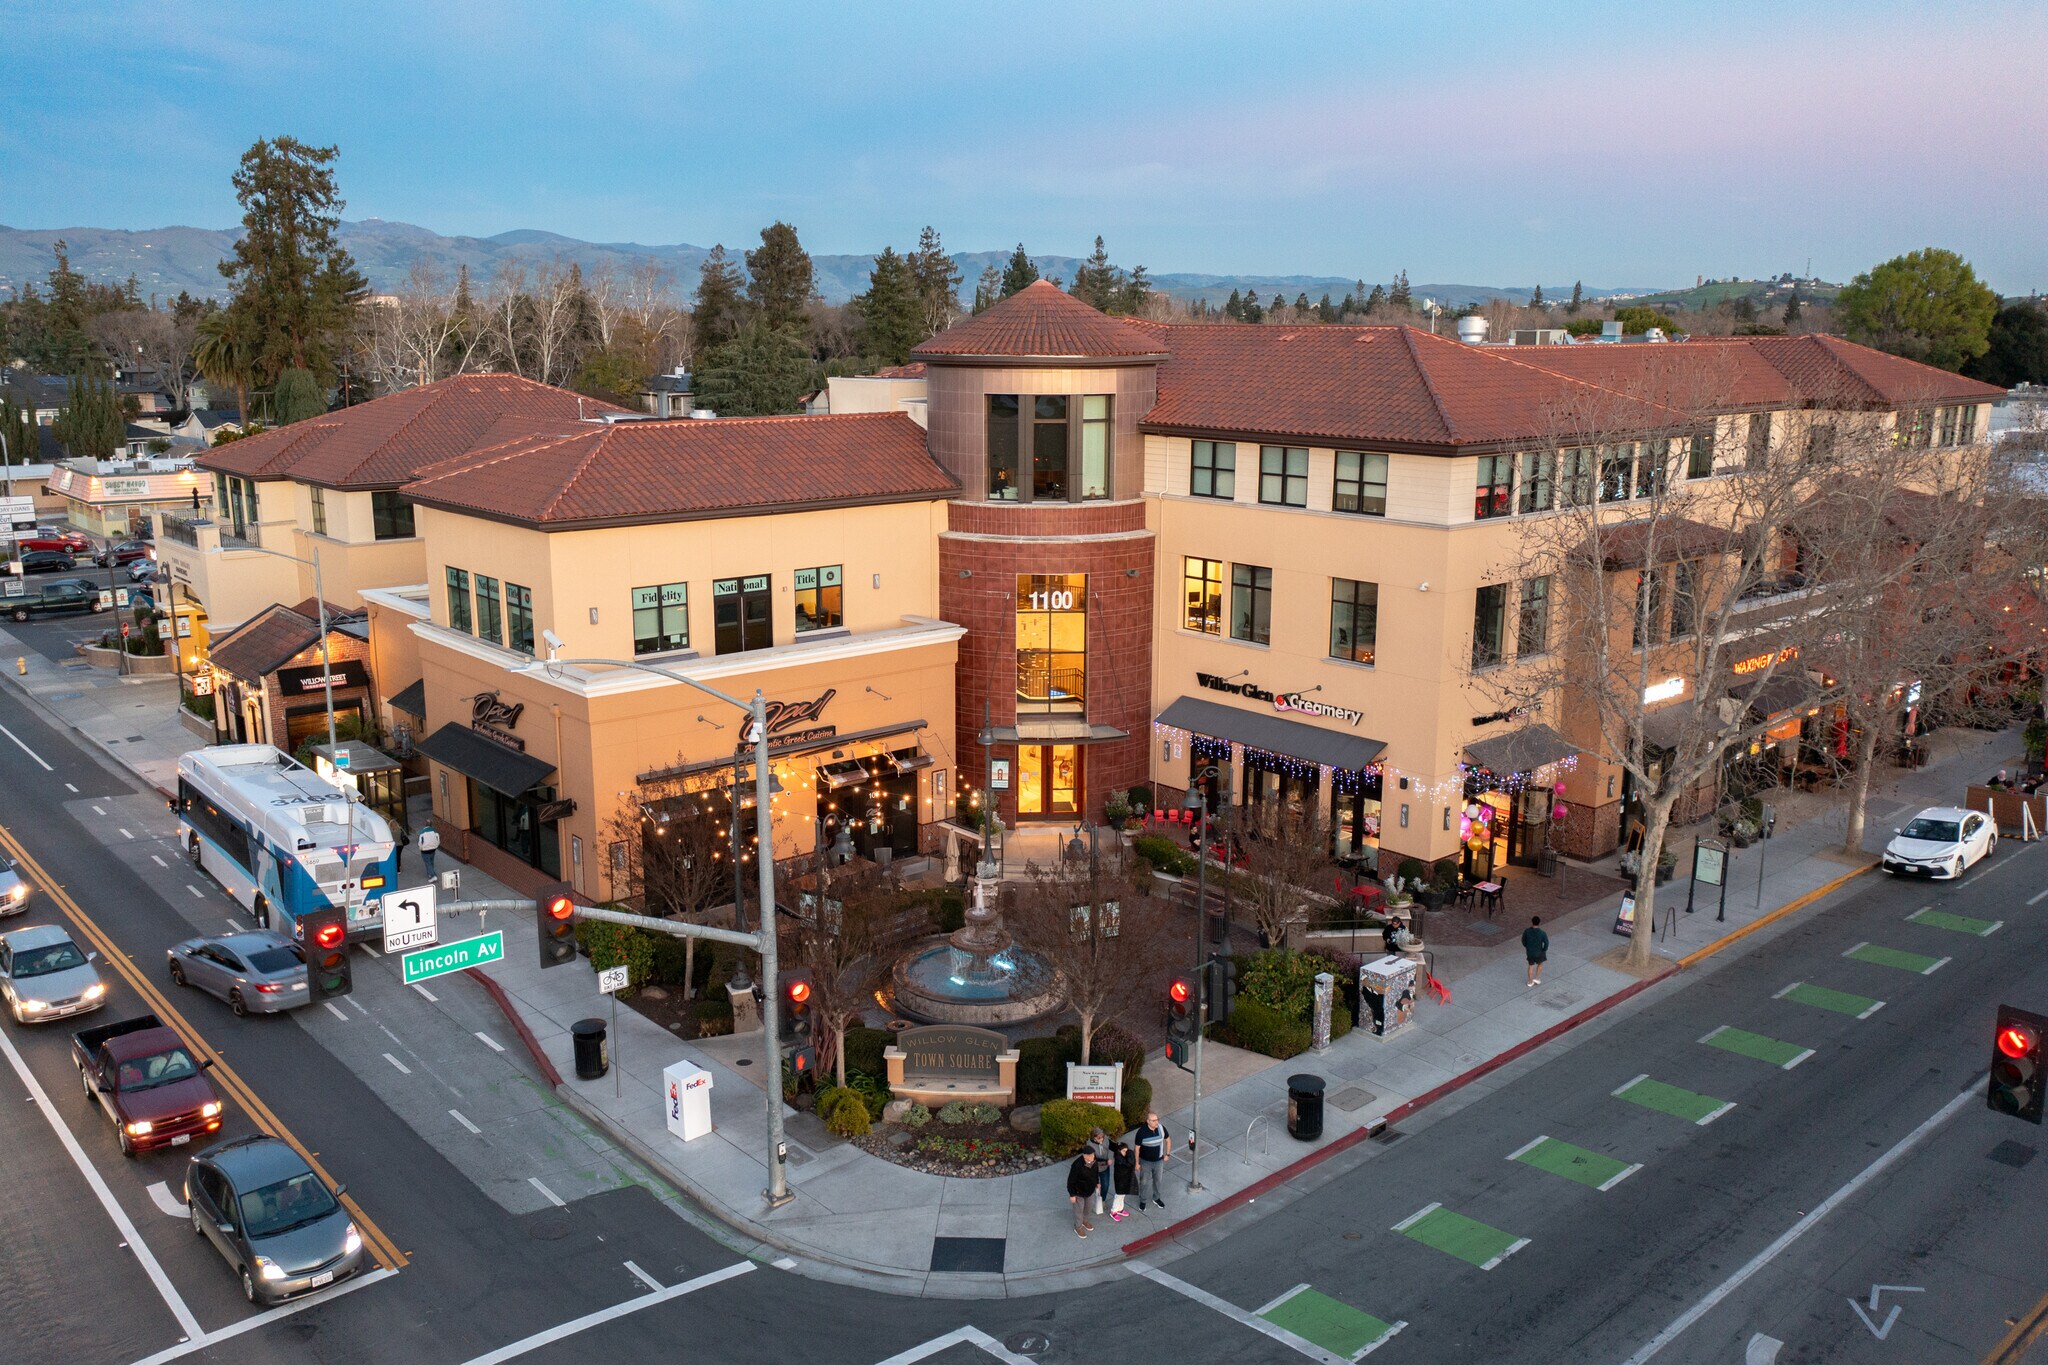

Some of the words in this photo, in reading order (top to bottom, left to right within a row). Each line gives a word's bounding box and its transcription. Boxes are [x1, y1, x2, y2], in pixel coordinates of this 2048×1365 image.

[641, 590, 683, 604] Fidelity
[718, 579, 764, 594] National
[795, 574, 816, 586] Title
[1029, 590, 1073, 610] 1100
[1734, 655, 1767, 674] WAXING
[327, 673, 347, 682] TREET
[1196, 672, 1242, 695] Willow
[1242, 683, 1274, 703] Glen
[1289, 693, 1364, 727] Creamery
[744, 739, 782, 753] Auntic
[783, 732, 806, 746] Greek
[807, 730, 833, 741] Cuisine
[270, 793, 344, 807] 3469
[305, 858, 320, 866] 3469
[389, 938, 401, 948] NO
[402, 934, 411, 946] U
[412, 930, 433, 943] TURN
[408, 949, 469, 976] Lincoln
[477, 942, 498, 958] Av
[906, 1035, 958, 1048] WILLOW
[965, 1036, 999, 1050] GLEN
[913, 1052, 945, 1068] TOWN
[949, 1054, 992, 1069] SQUARE
[686, 1078, 706, 1091] FedEx
[670, 1081, 679, 1121] FedEx
